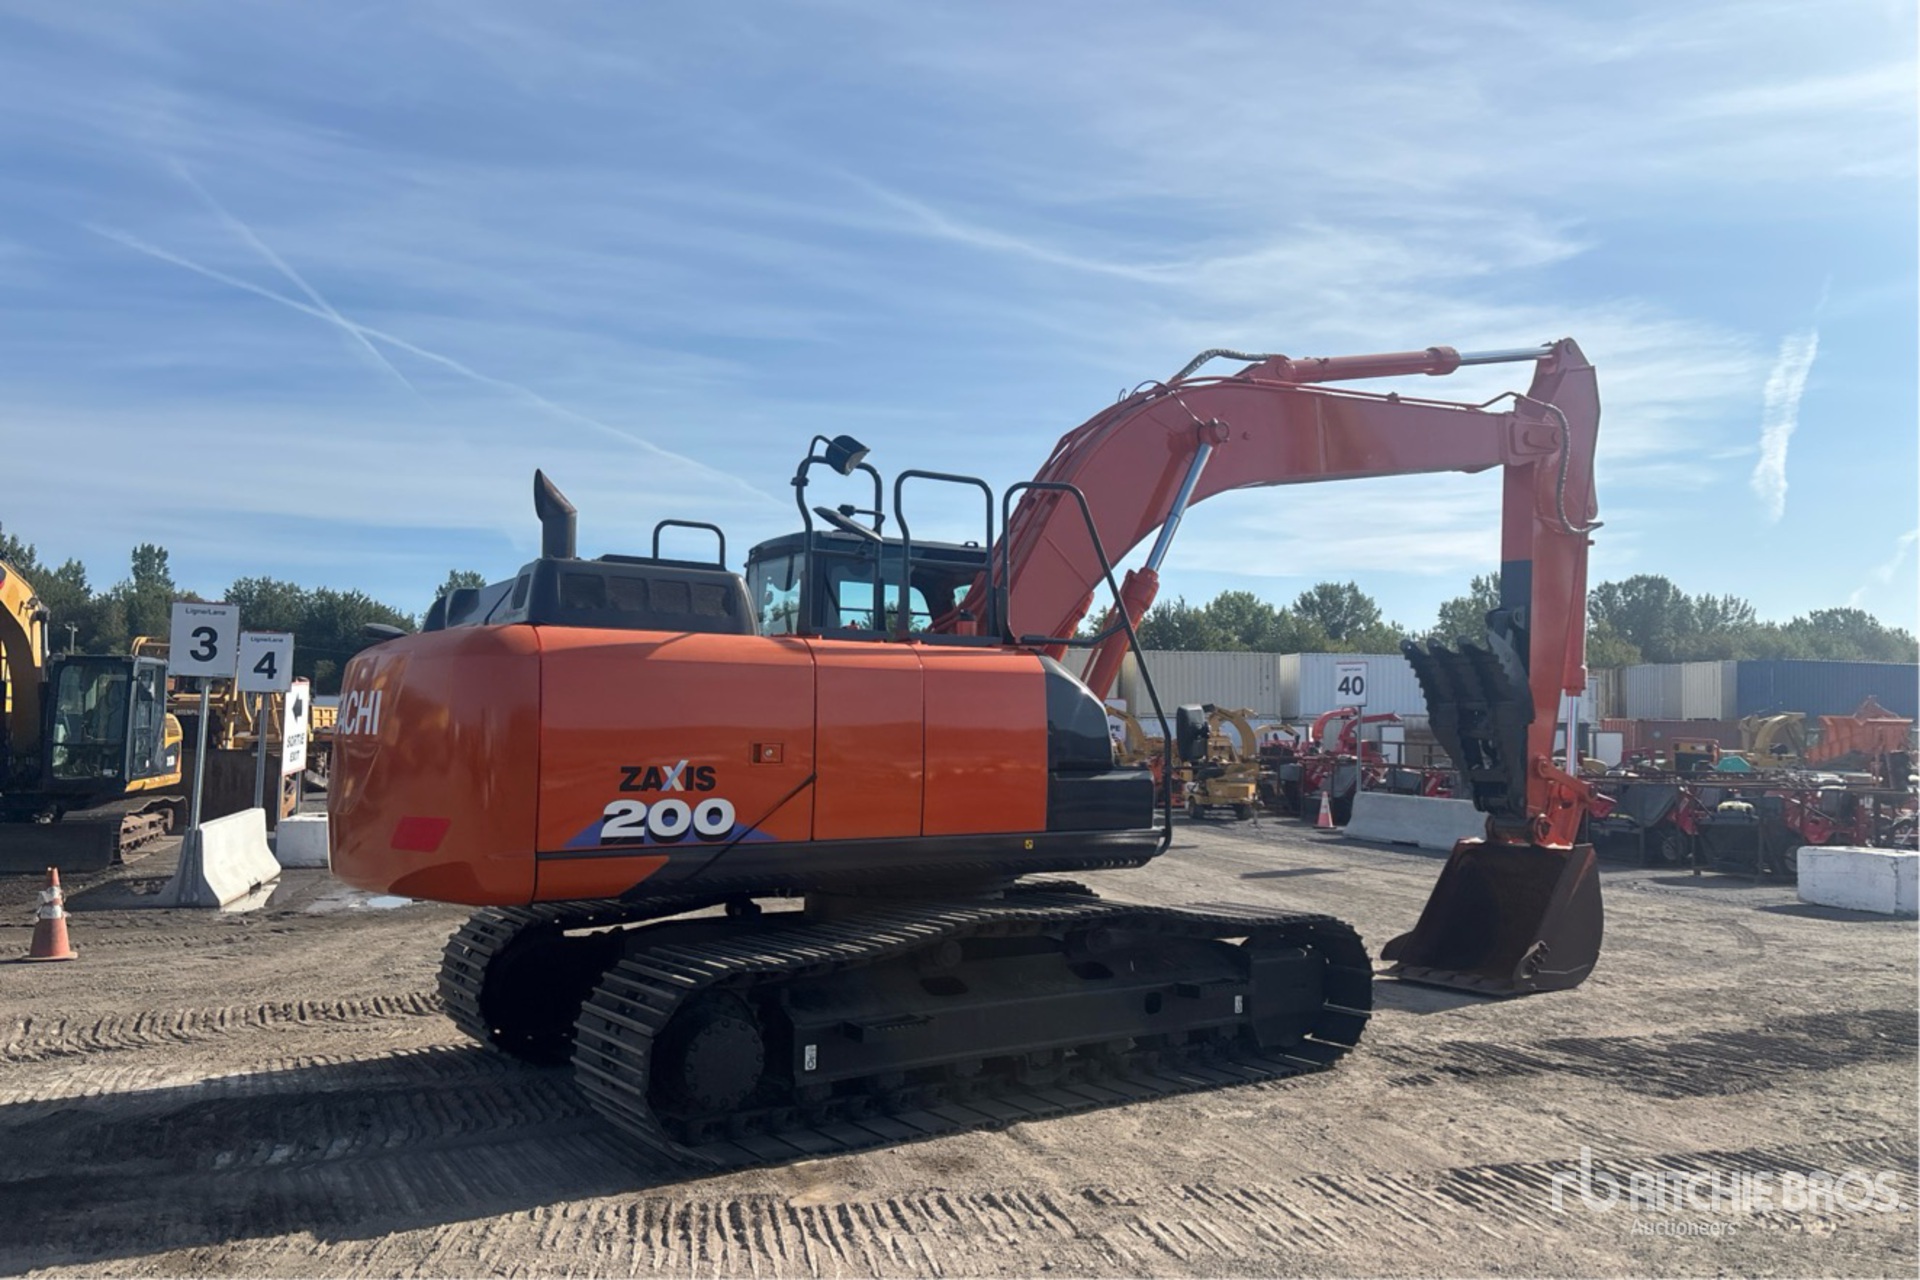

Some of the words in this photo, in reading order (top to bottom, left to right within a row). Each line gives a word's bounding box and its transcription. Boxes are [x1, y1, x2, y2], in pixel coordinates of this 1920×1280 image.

[190, 626, 218, 662] 3
[253, 651, 277, 680] 4
[1337, 675, 1365, 696] 40
[619, 759, 717, 791] ZAXIS
[600, 797, 736, 844] 200
